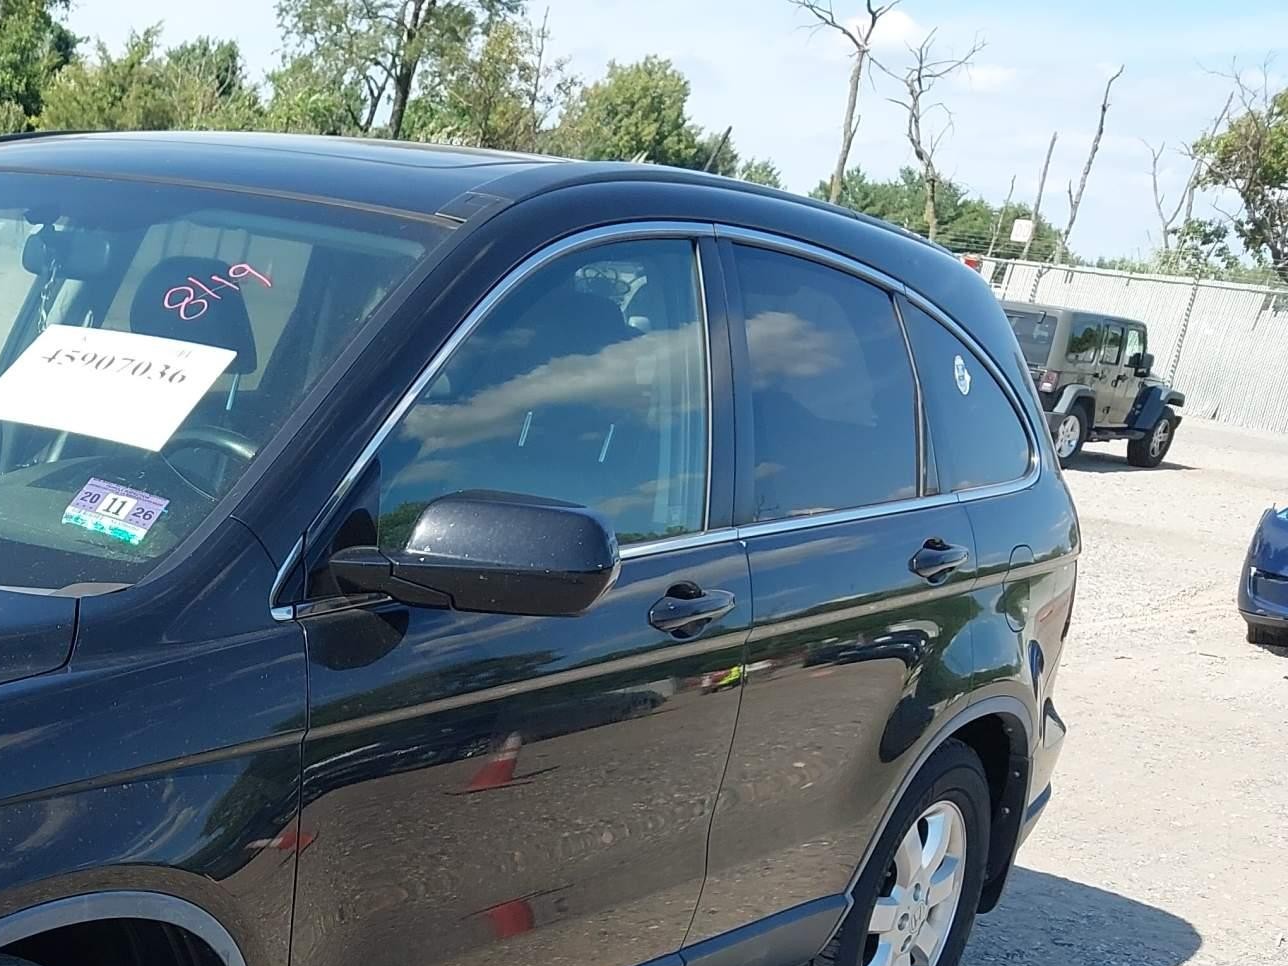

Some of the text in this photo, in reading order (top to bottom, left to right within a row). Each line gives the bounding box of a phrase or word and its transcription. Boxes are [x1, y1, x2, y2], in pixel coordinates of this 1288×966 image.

[41, 347, 188, 386] 45907036
[79, 491, 101, 504] 20
[102, 497, 128, 516] 11
[131, 507, 155, 521] 26
